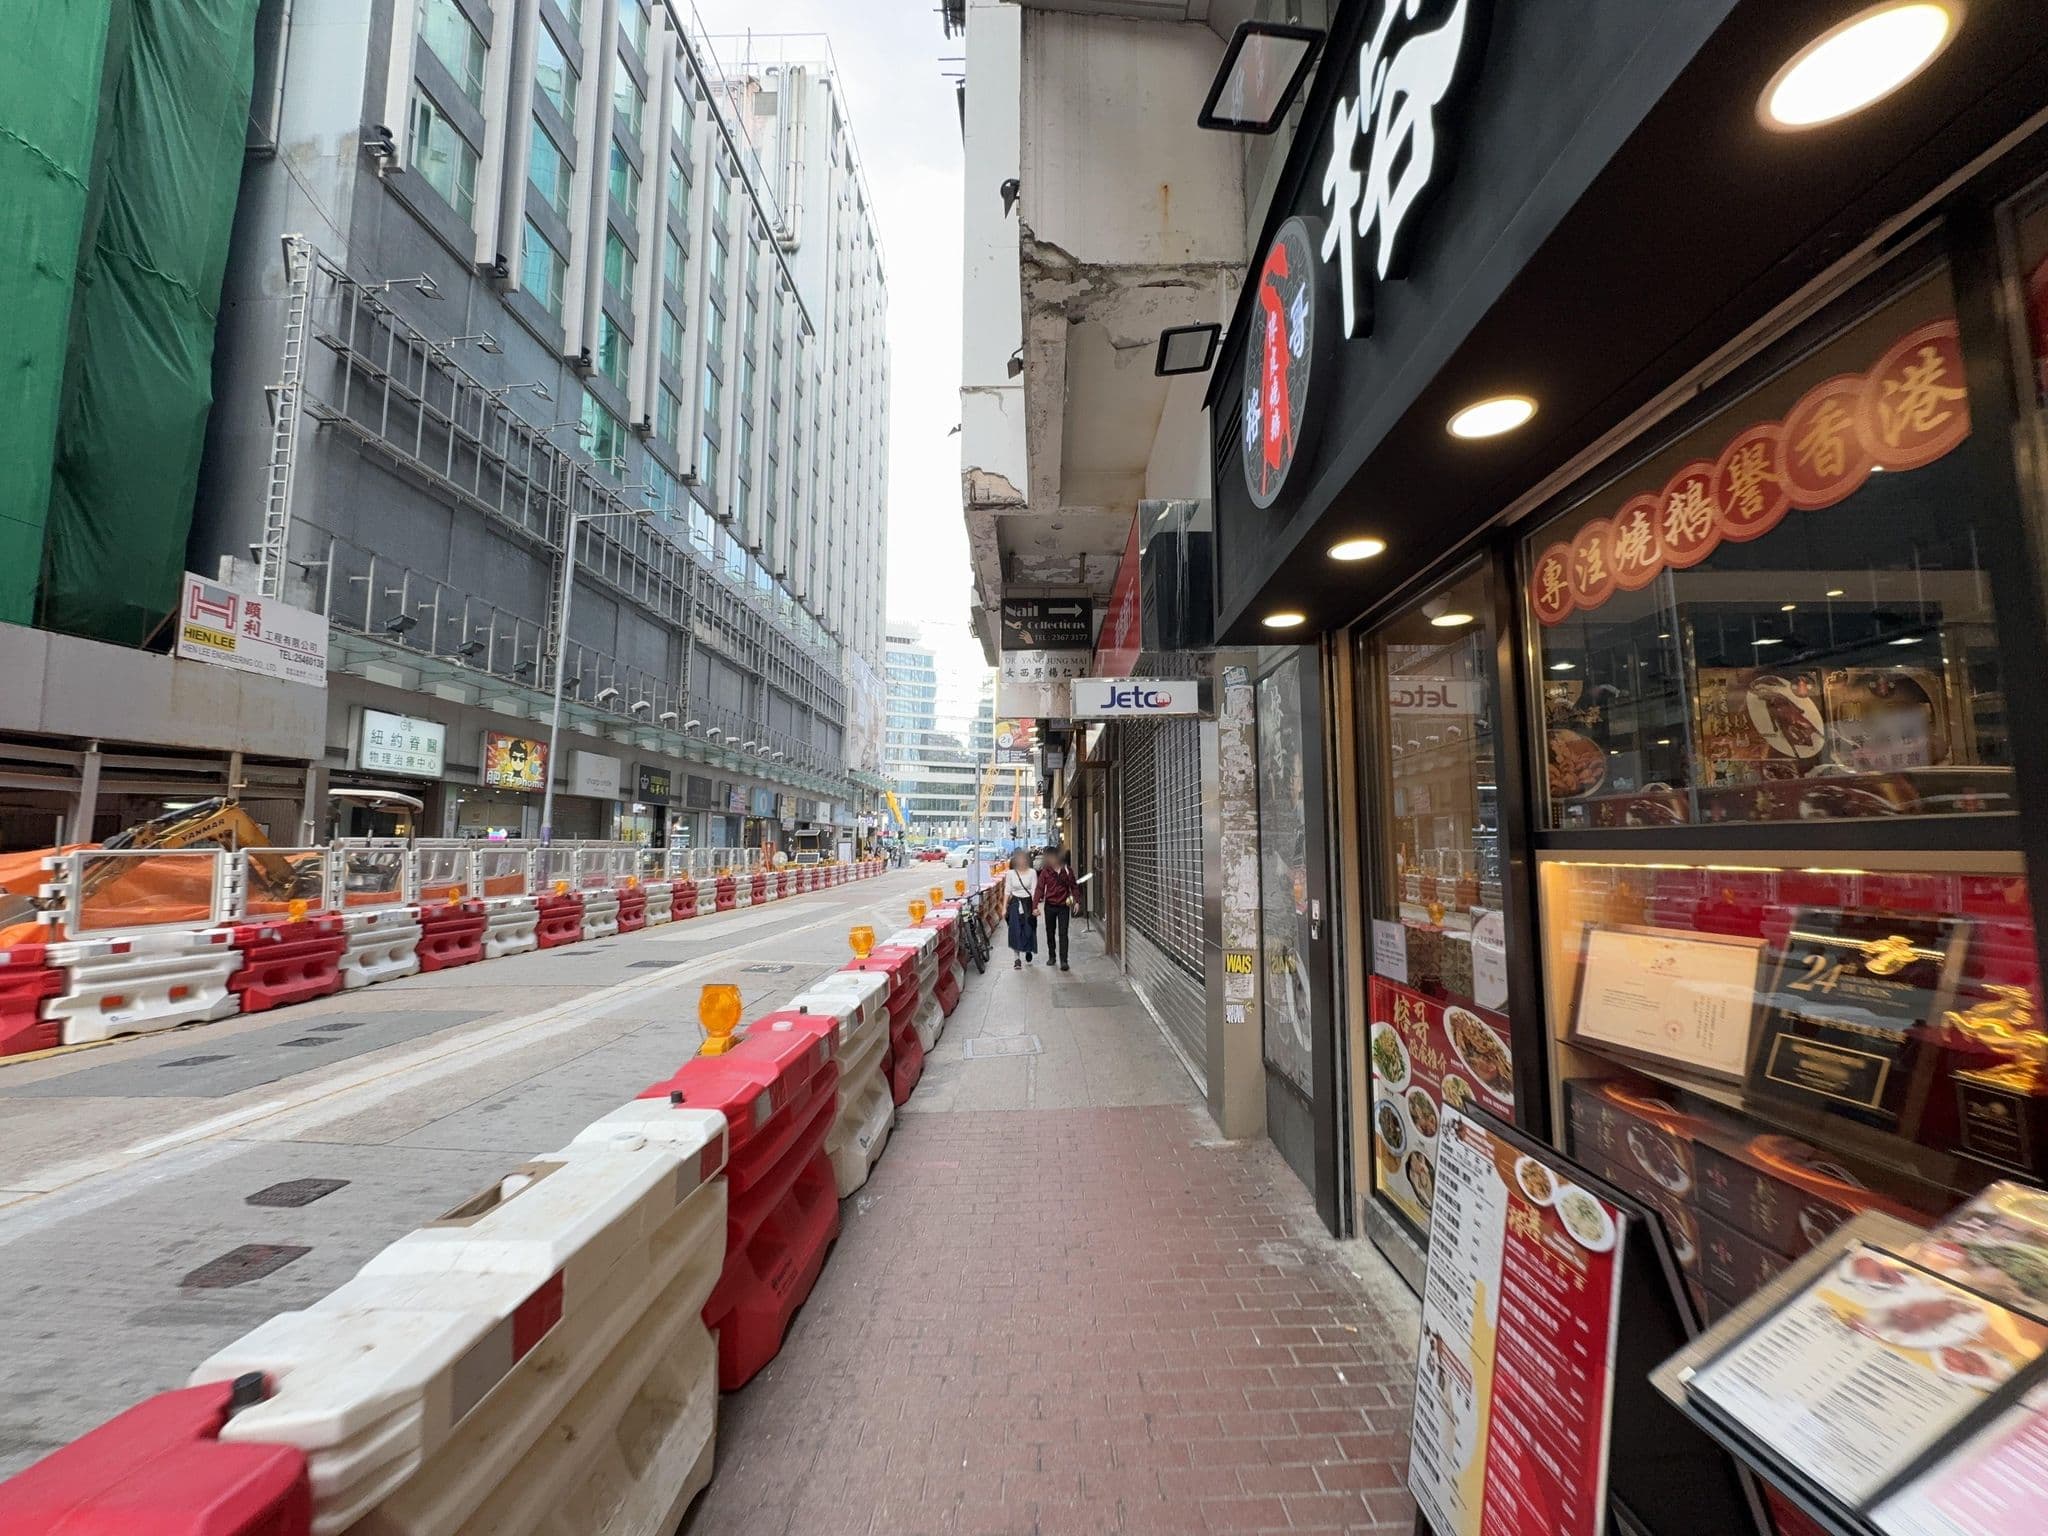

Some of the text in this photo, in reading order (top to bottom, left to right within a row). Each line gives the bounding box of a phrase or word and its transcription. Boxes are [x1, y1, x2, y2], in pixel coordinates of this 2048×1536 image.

[1004, 605, 1039, 617] Nail
[1027, 620, 1086, 630] Collections
[183, 626, 236, 650] HIEN LEE
[264, 630, 318, 654] 工程有限公司
[211, 650, 253, 667] ENGINEERING
[1046, 656, 1068, 665] JUNG
[1071, 656, 1087, 665] MAI
[1101, 685, 1172, 709] Jetco
[370, 728, 438, 754] 紐約脊醫
[368, 750, 436, 770] 物理治療中心
[180, 818, 225, 842] YANMAR
[1225, 953, 1252, 974] WAIS
